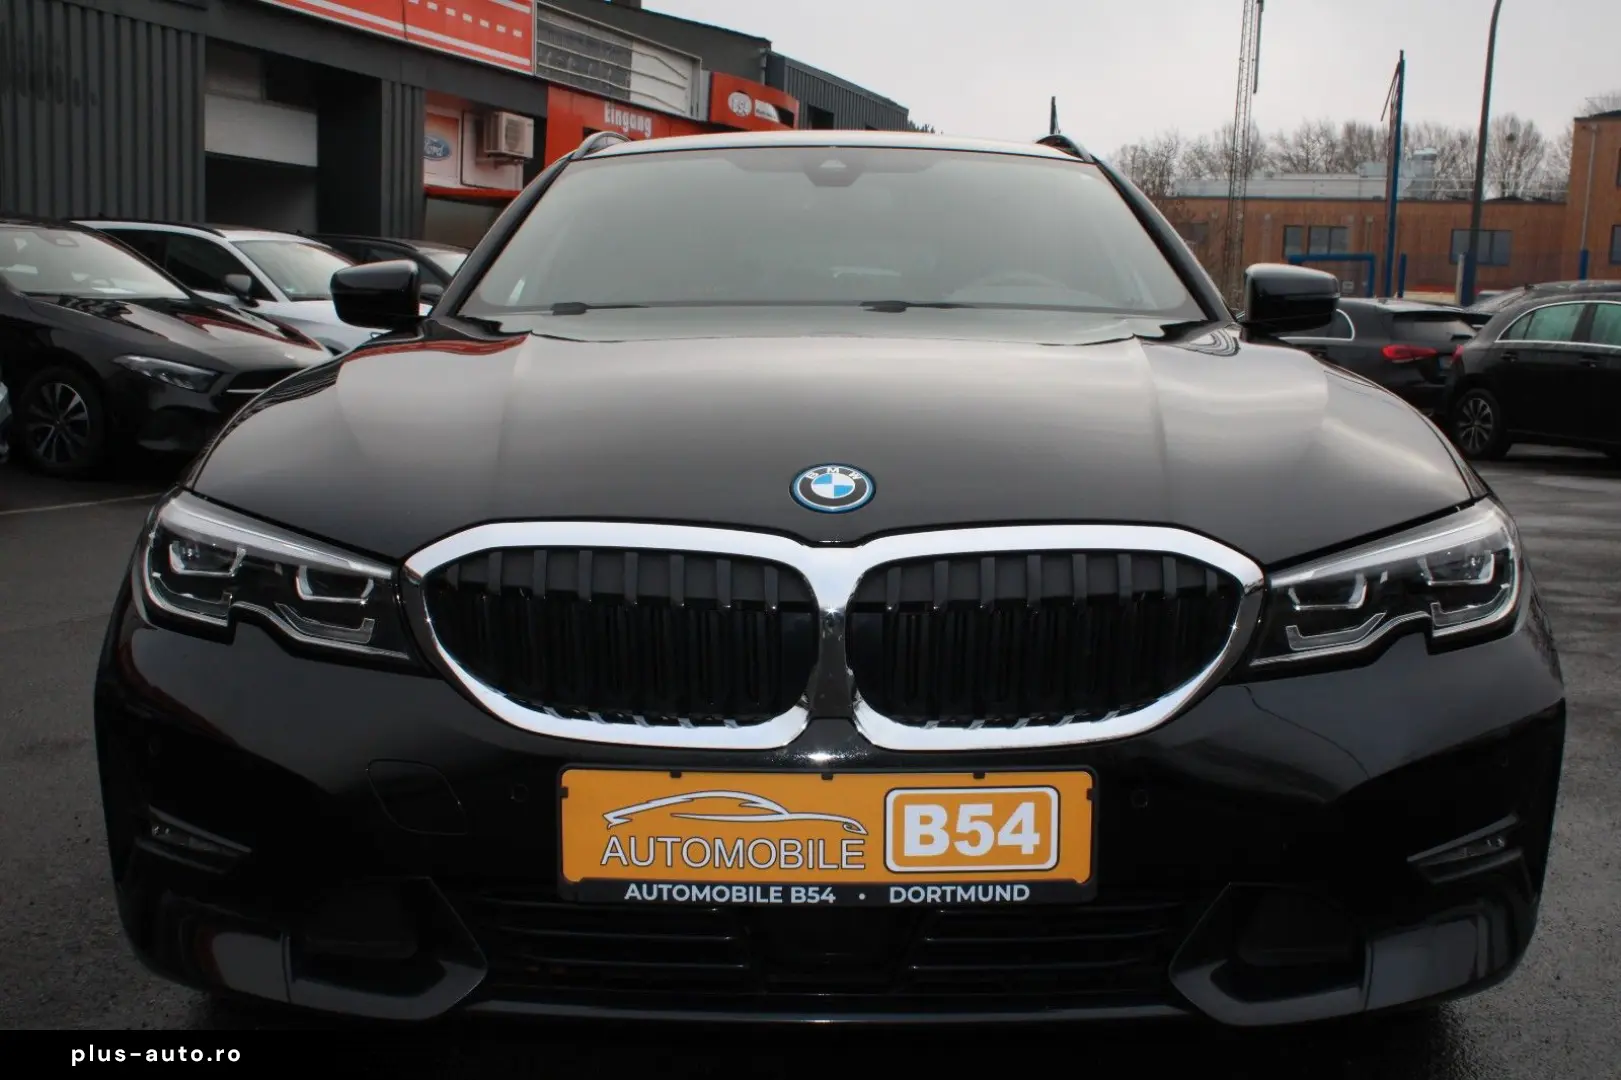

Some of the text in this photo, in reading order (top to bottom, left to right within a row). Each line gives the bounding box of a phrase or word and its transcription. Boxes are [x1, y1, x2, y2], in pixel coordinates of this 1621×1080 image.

[604, 100, 652, 138] Eingang
[805, 466, 862, 480] BMW
[904, 802, 1040, 857] B54
[600, 834, 866, 870] AUTOMOBILE
[624, 882, 1031, 904] AUTOMOBILE B54 DORTMUND
